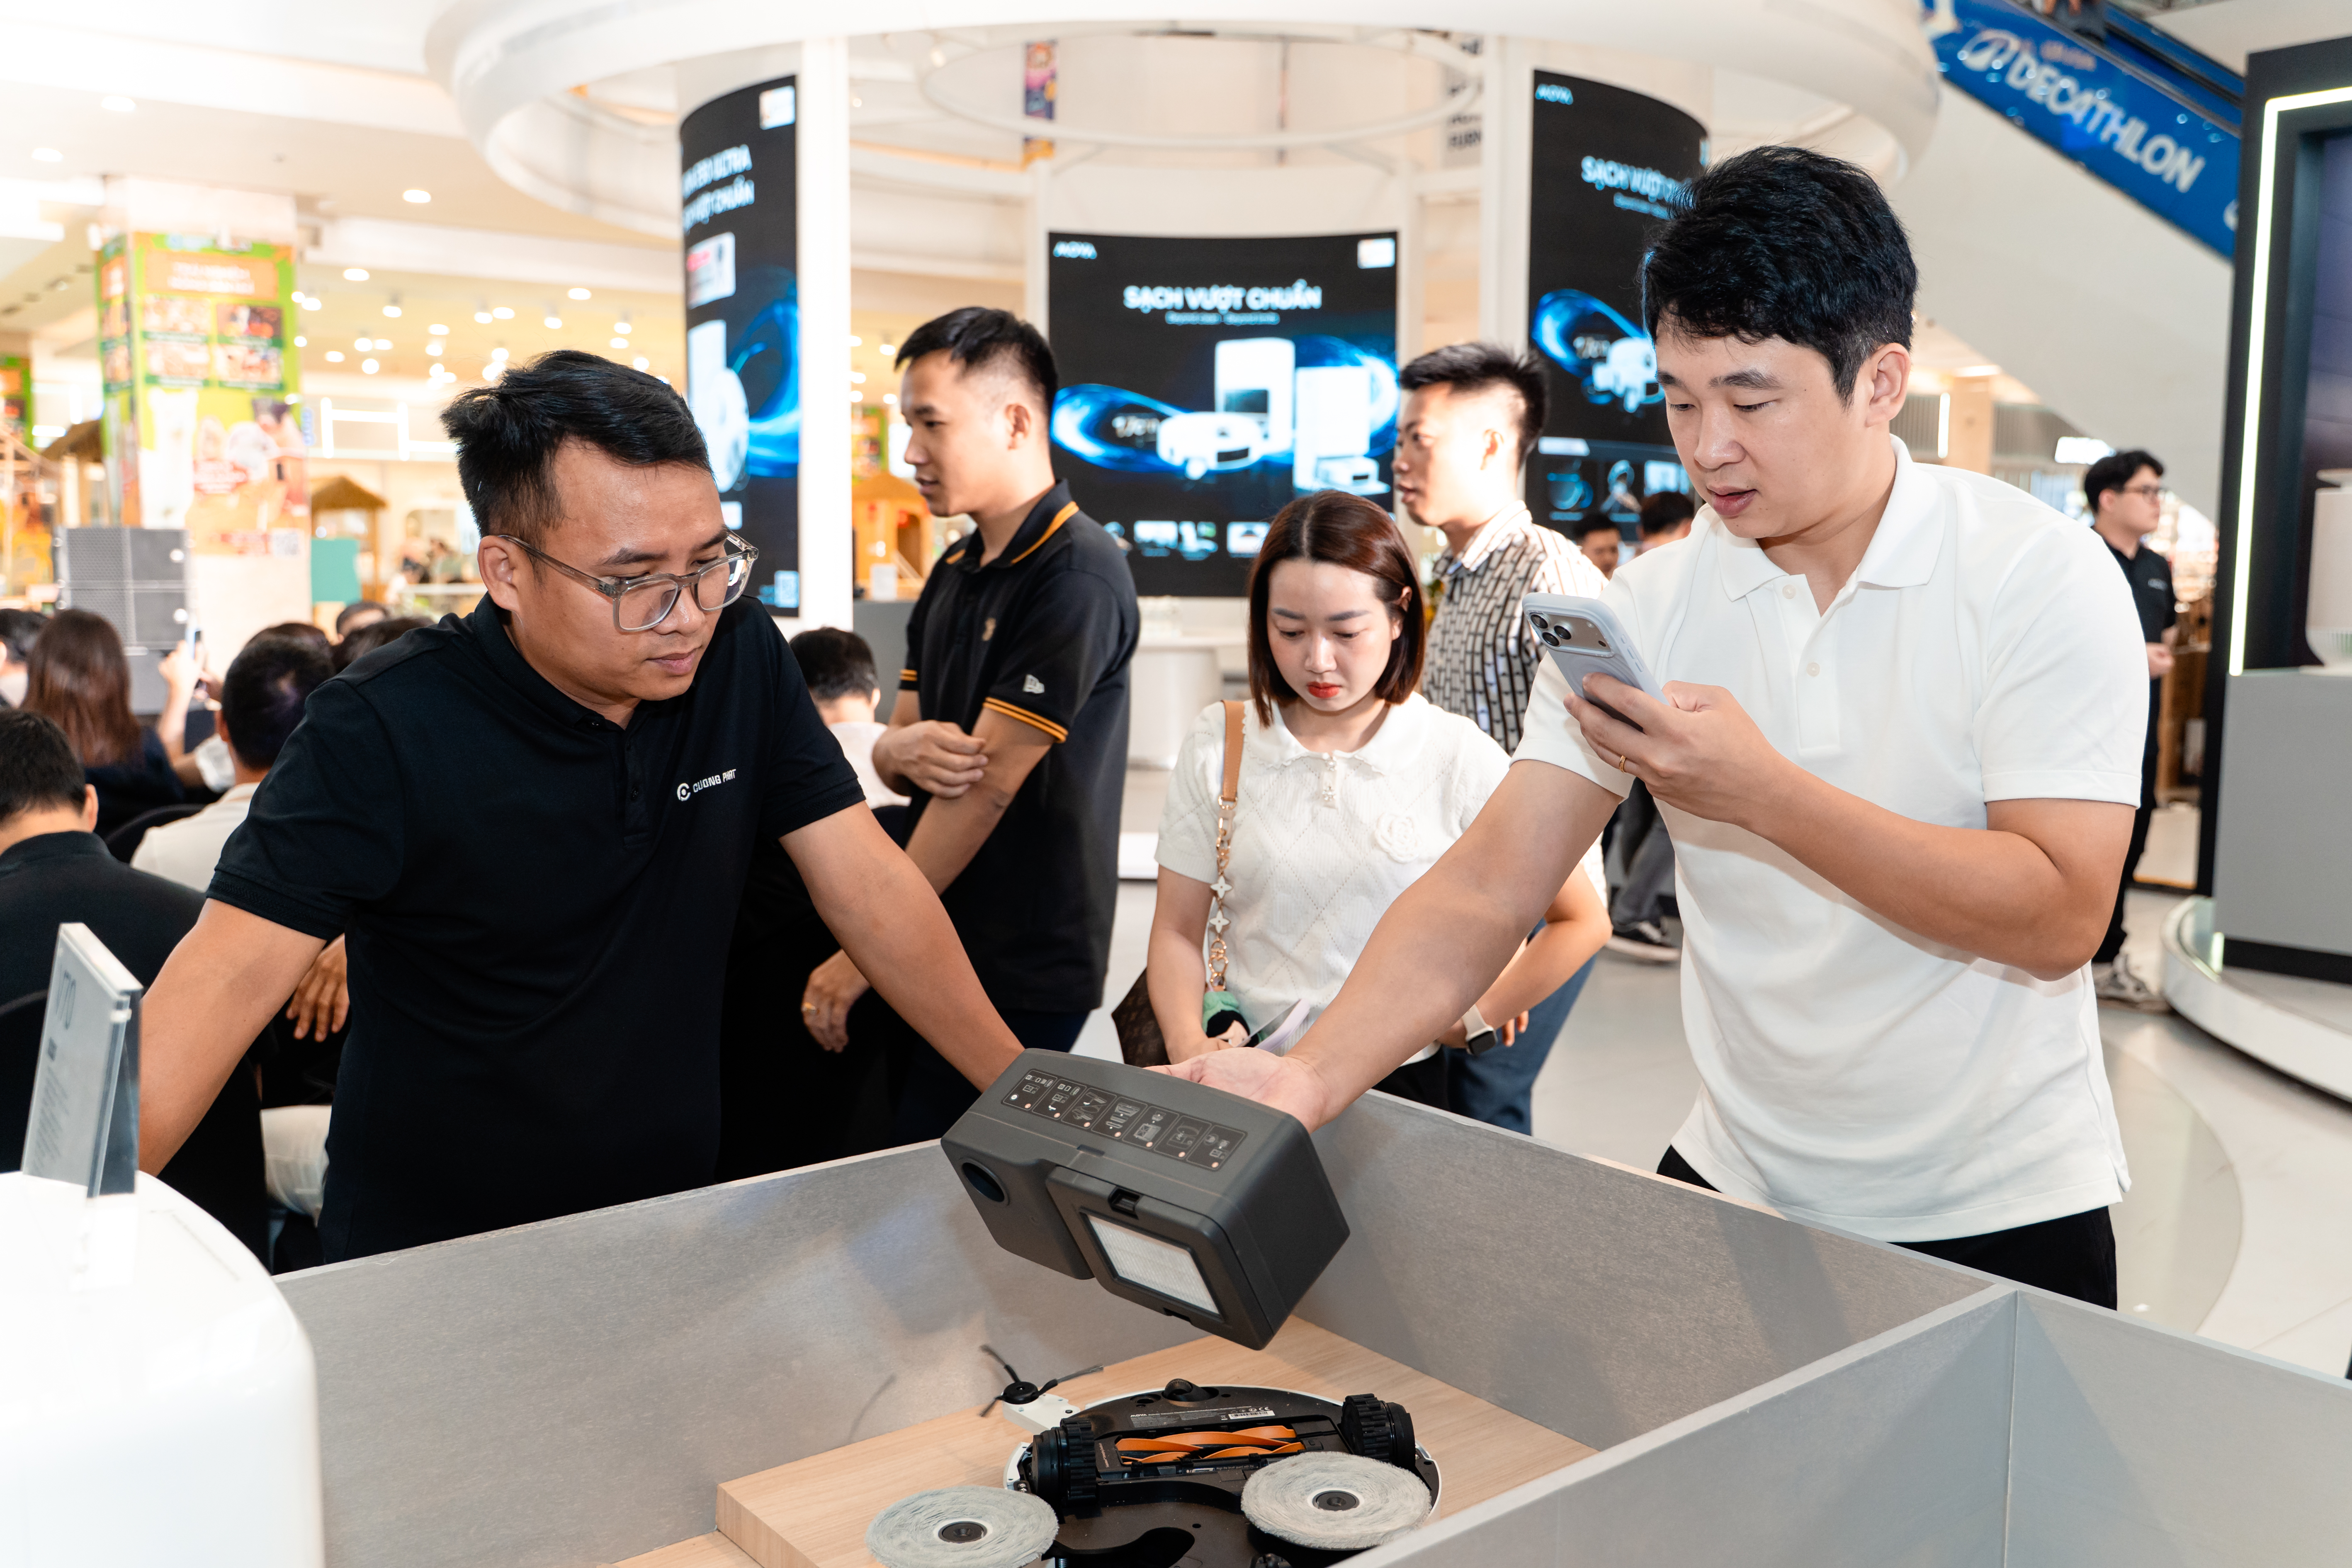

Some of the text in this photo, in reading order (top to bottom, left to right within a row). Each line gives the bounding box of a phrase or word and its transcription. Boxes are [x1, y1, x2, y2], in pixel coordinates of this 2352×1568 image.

[2005, 50, 2206, 193] DECATHLON
[1123, 278, 1322, 314] SẠCH VƯỢT CHUẨN
